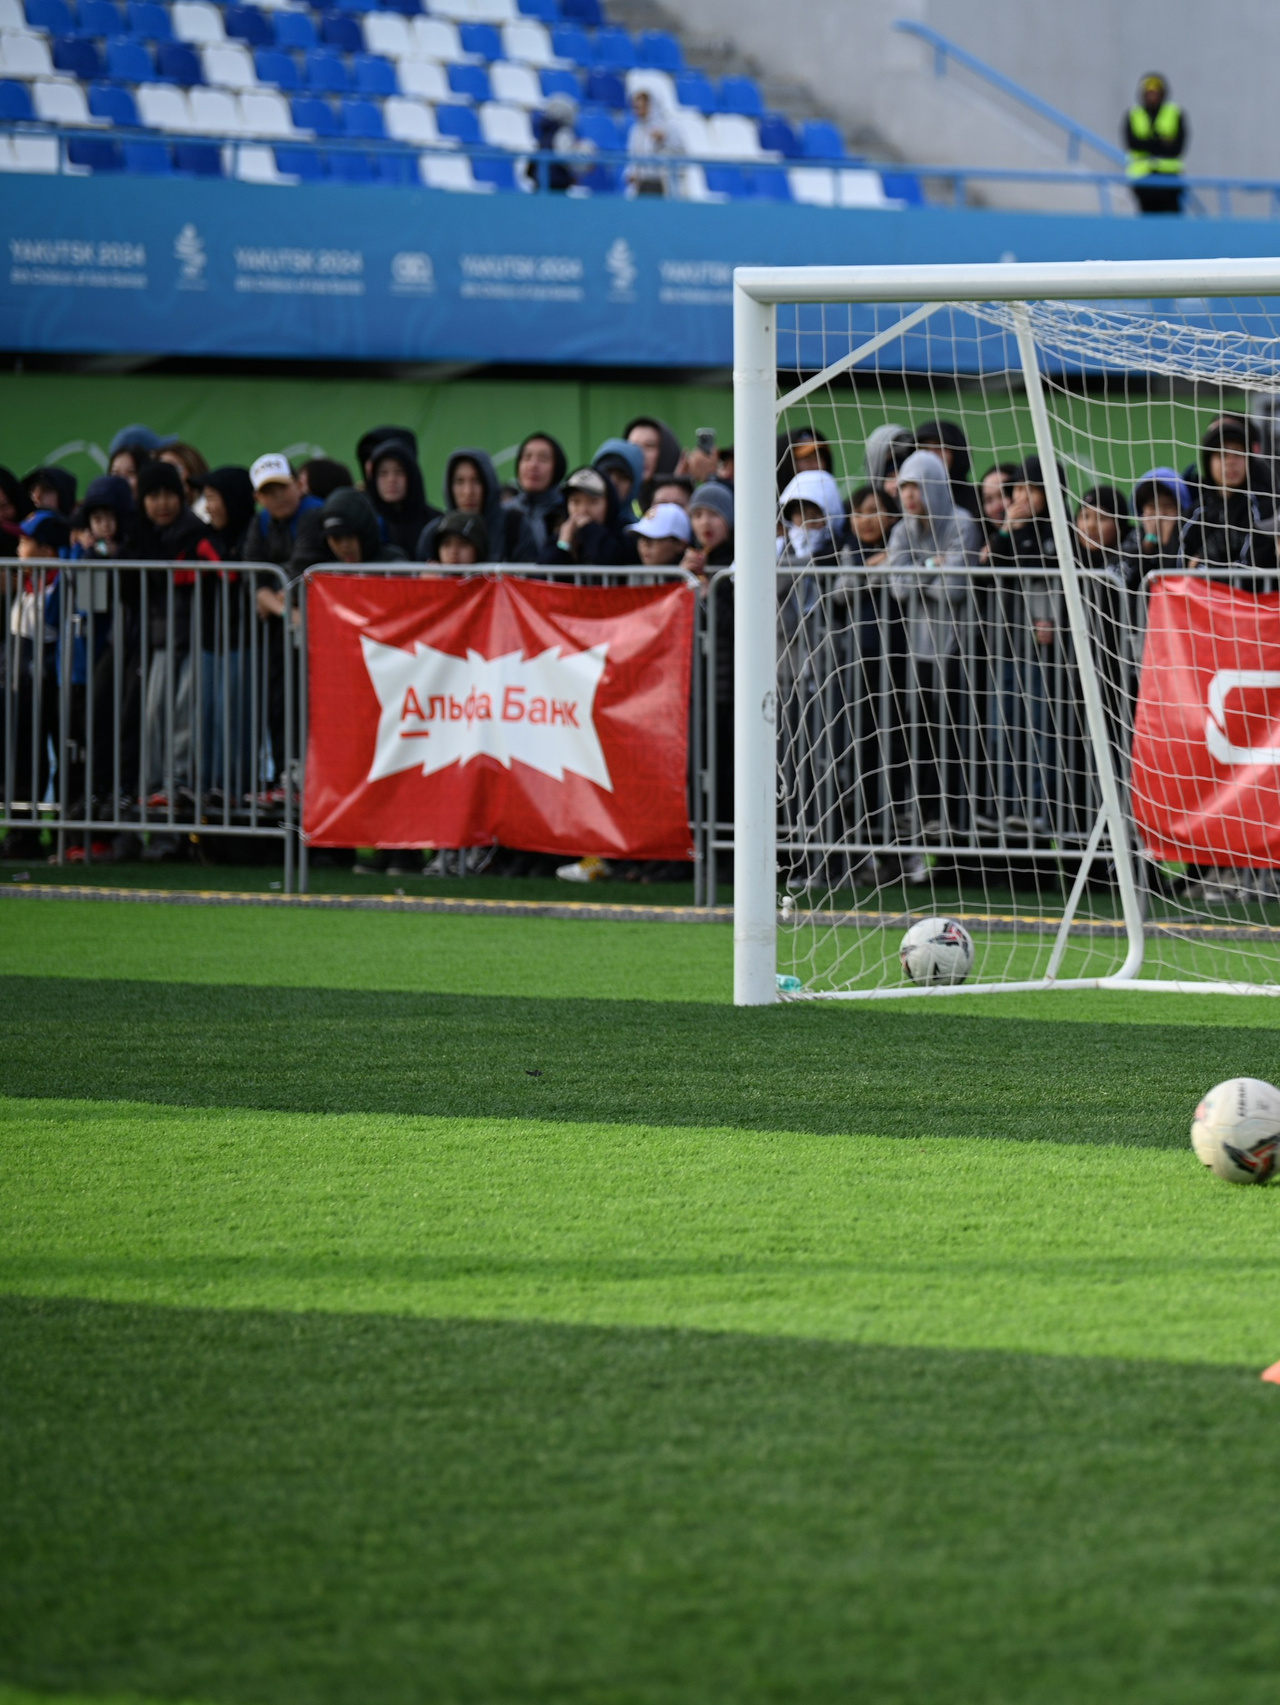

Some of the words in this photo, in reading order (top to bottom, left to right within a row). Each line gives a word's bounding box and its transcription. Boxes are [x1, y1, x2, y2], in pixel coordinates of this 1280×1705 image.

[10, 239, 94, 266] YAKUTSK
[98, 241, 146, 267] 2024
[234, 248, 314, 274] YAKUTSK
[400, 685, 492, 729] Альфа
[501, 685, 581, 729] Банк
